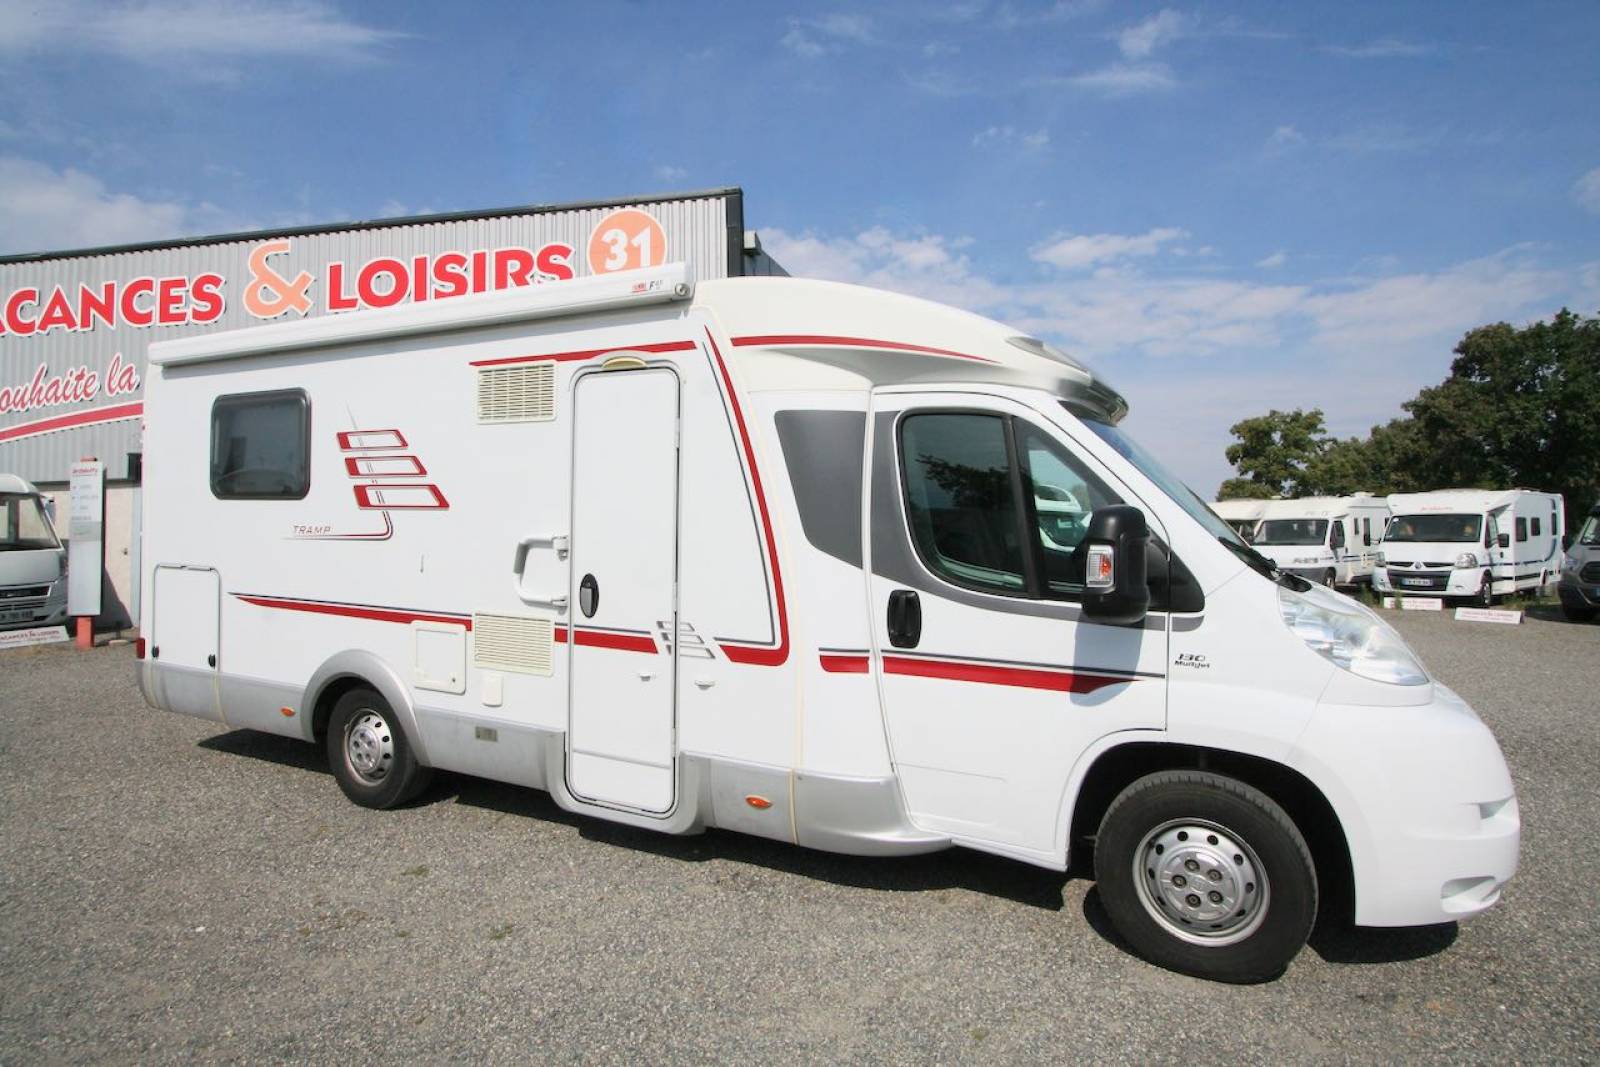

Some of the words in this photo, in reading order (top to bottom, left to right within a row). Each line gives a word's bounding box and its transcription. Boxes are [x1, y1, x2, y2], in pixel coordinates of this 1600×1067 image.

[244, 238, 315, 318] &
[328, 243, 576, 312] LOISIRS
[602, 223, 651, 270] 31
[106, 352, 140, 396] la
[294, 525, 331, 535] TRAMP
